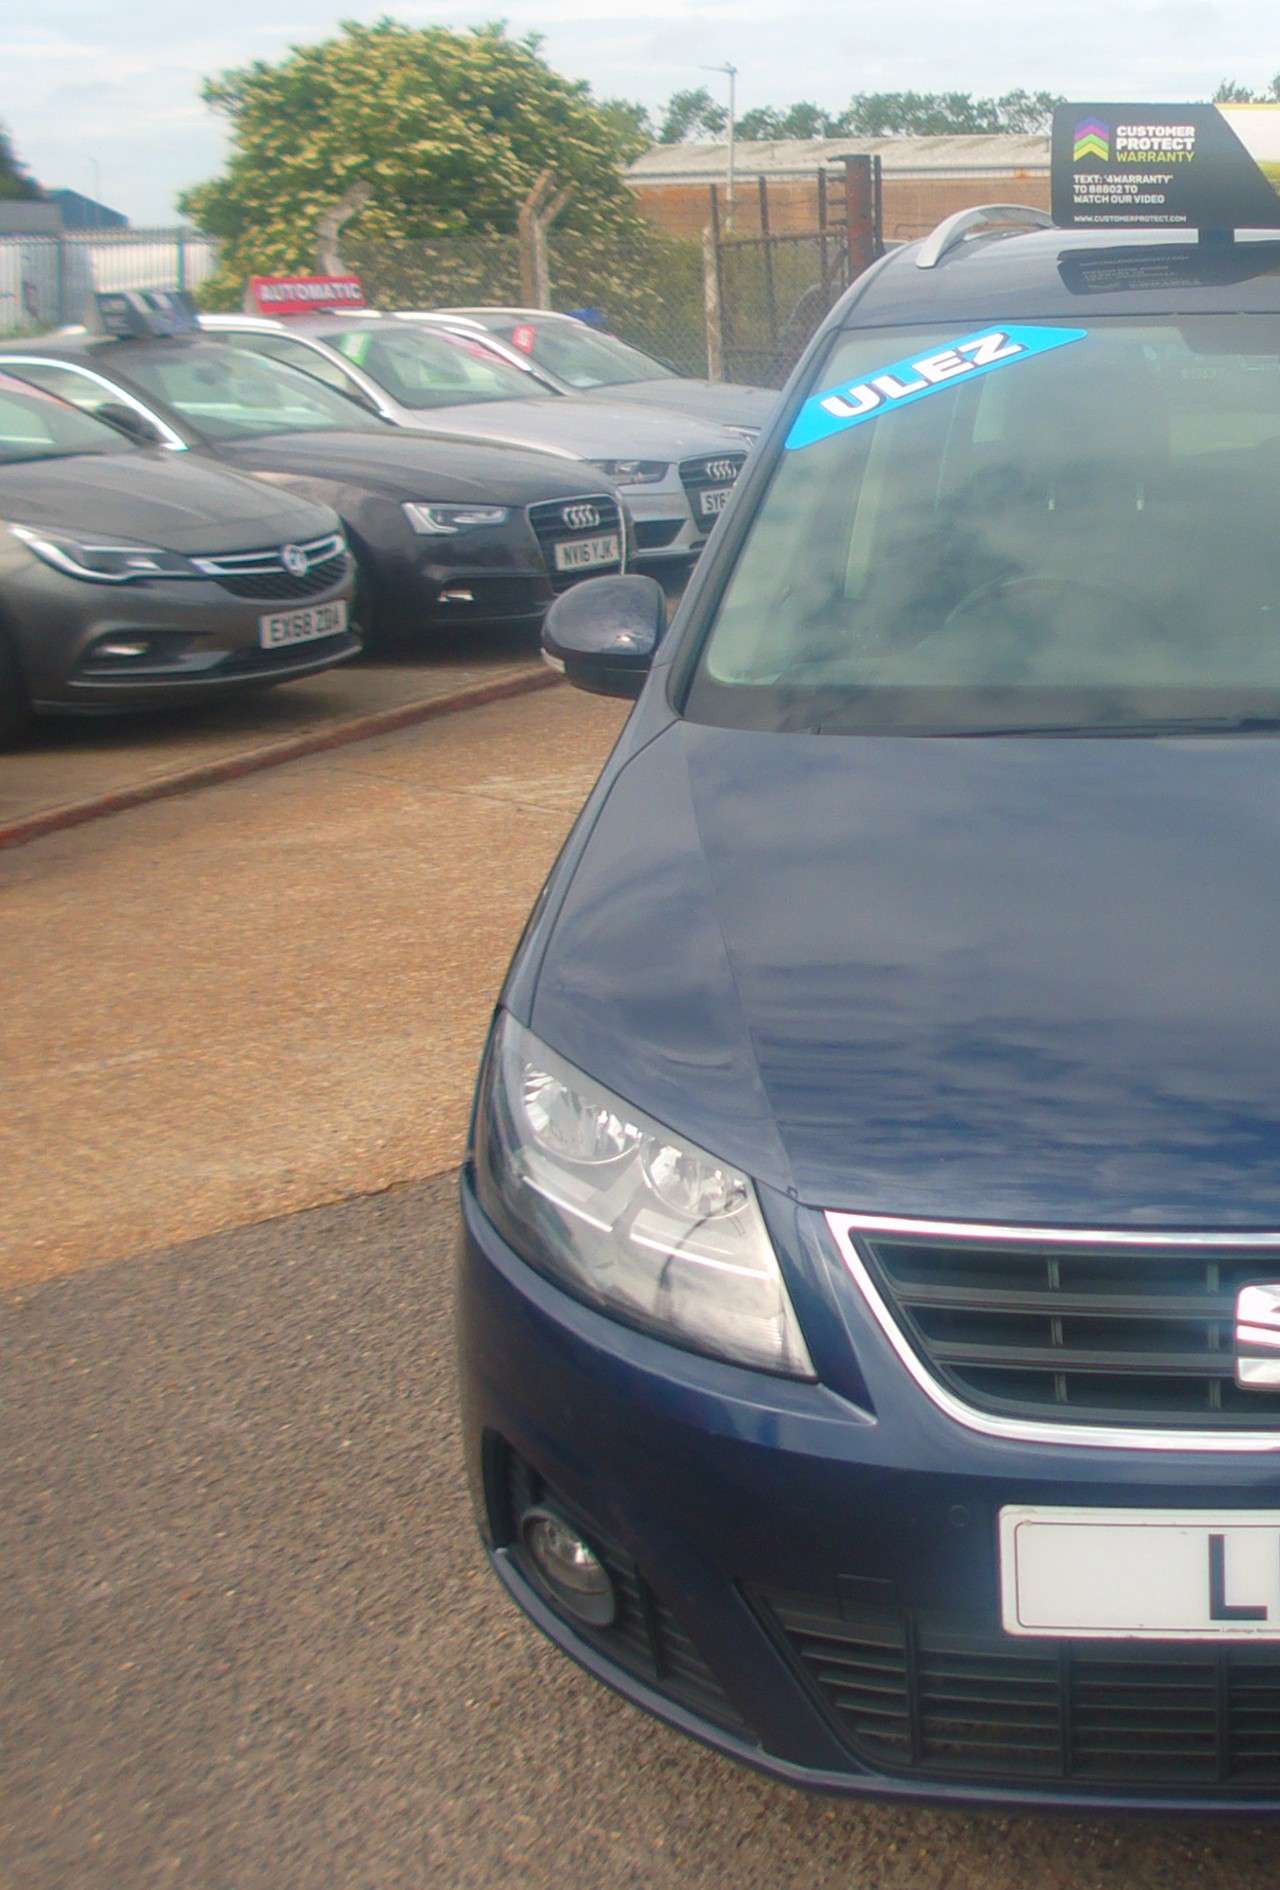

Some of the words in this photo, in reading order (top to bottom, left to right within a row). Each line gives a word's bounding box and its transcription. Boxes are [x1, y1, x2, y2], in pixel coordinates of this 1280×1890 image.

[1116, 126, 1195, 137] CUSTOMER
[1116, 138, 1195, 150] PROTECT
[1116, 151, 1195, 162] WARRANTY
[1073, 184, 1087, 194] TO
[1124, 184, 1138, 194] TO
[1073, 194, 1109, 204] WATCH
[1110, 194, 1132, 204] OUR
[1133, 194, 1165, 204] VIDEO
[261, 282, 362, 301] AUTOMATIC
[820, 331, 1026, 418] ULEZ
[705, 491, 732, 511] SY6
[269, 611, 312, 642] EX68
